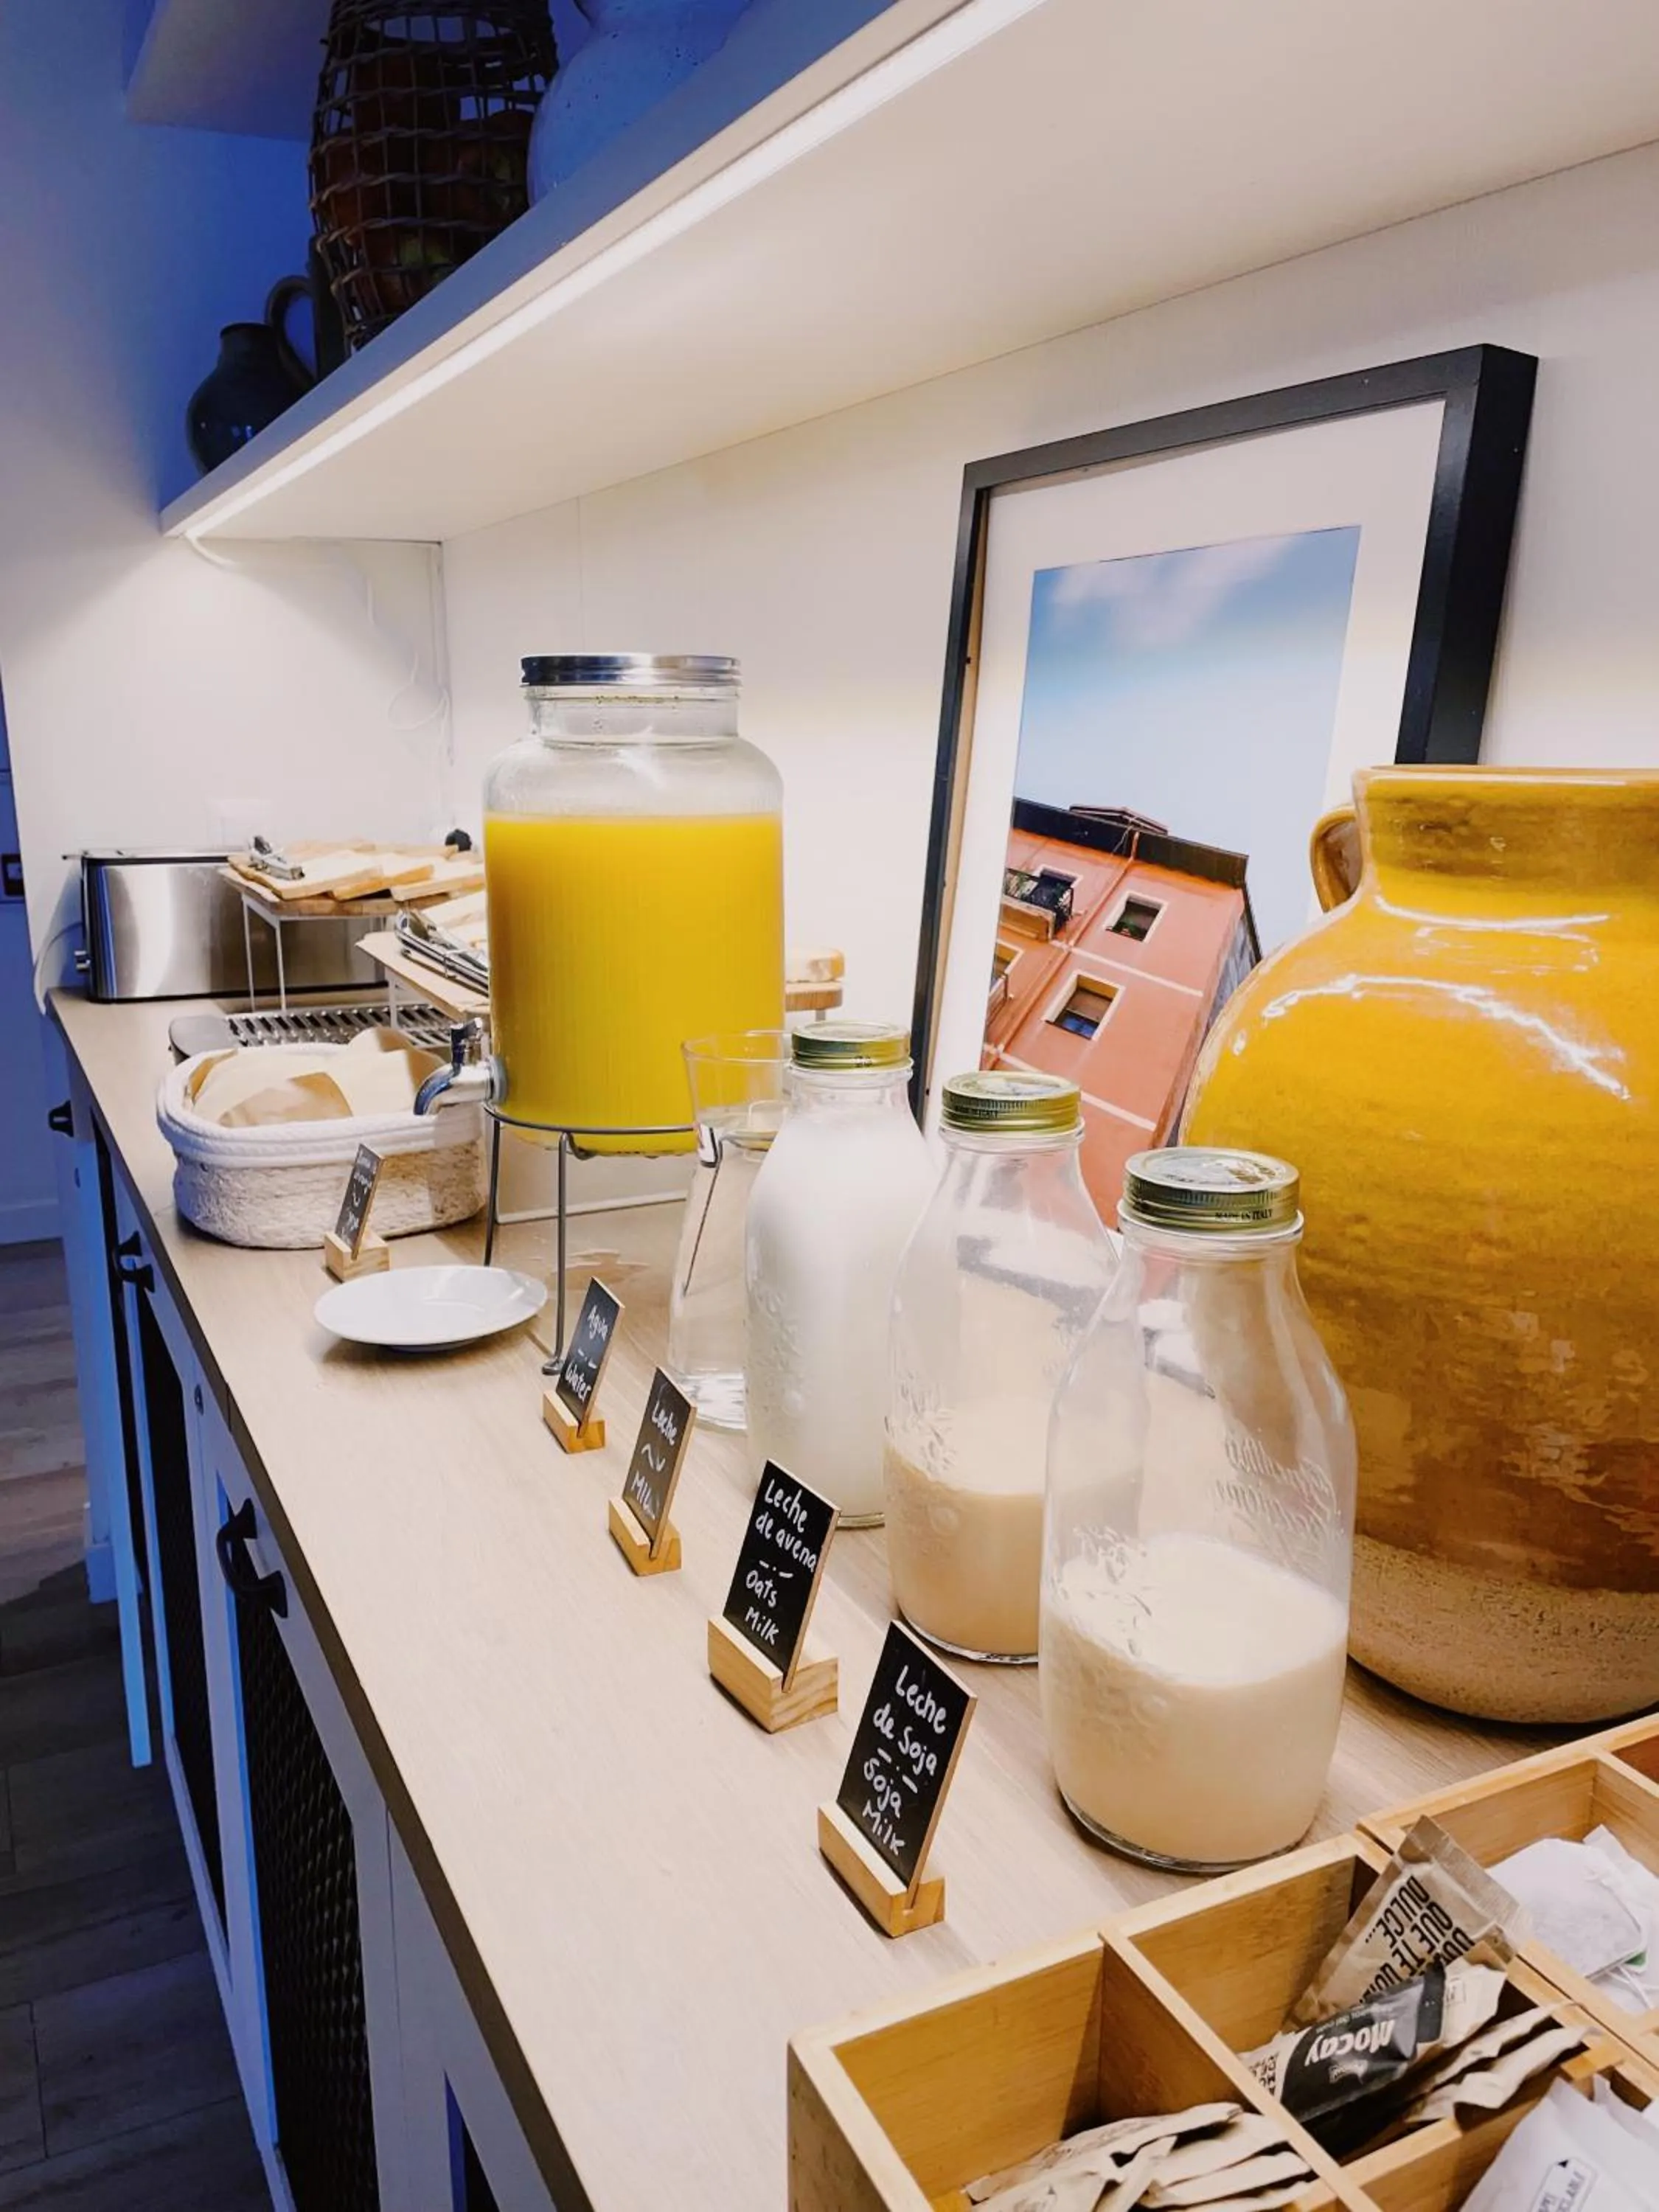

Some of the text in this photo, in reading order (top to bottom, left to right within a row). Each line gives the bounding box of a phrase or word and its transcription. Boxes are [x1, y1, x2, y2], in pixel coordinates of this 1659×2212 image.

[565, 1360, 592, 1402] Water
[652, 1401, 679, 1446] Leche
[764, 1478, 807, 1533] Leche
[755, 1512, 817, 1572] de avena
[745, 1570, 778, 1607] Oats
[745, 1606, 779, 1646] Milk
[895, 1665, 946, 1733] Leche
[873, 1703, 937, 1775] de Soja
[863, 1800, 905, 1855] Milk
[1410, 1901, 1454, 1954] QUE
[1391, 1938, 1425, 1976] TE
[1304, 2020, 1395, 2067] Mocay
